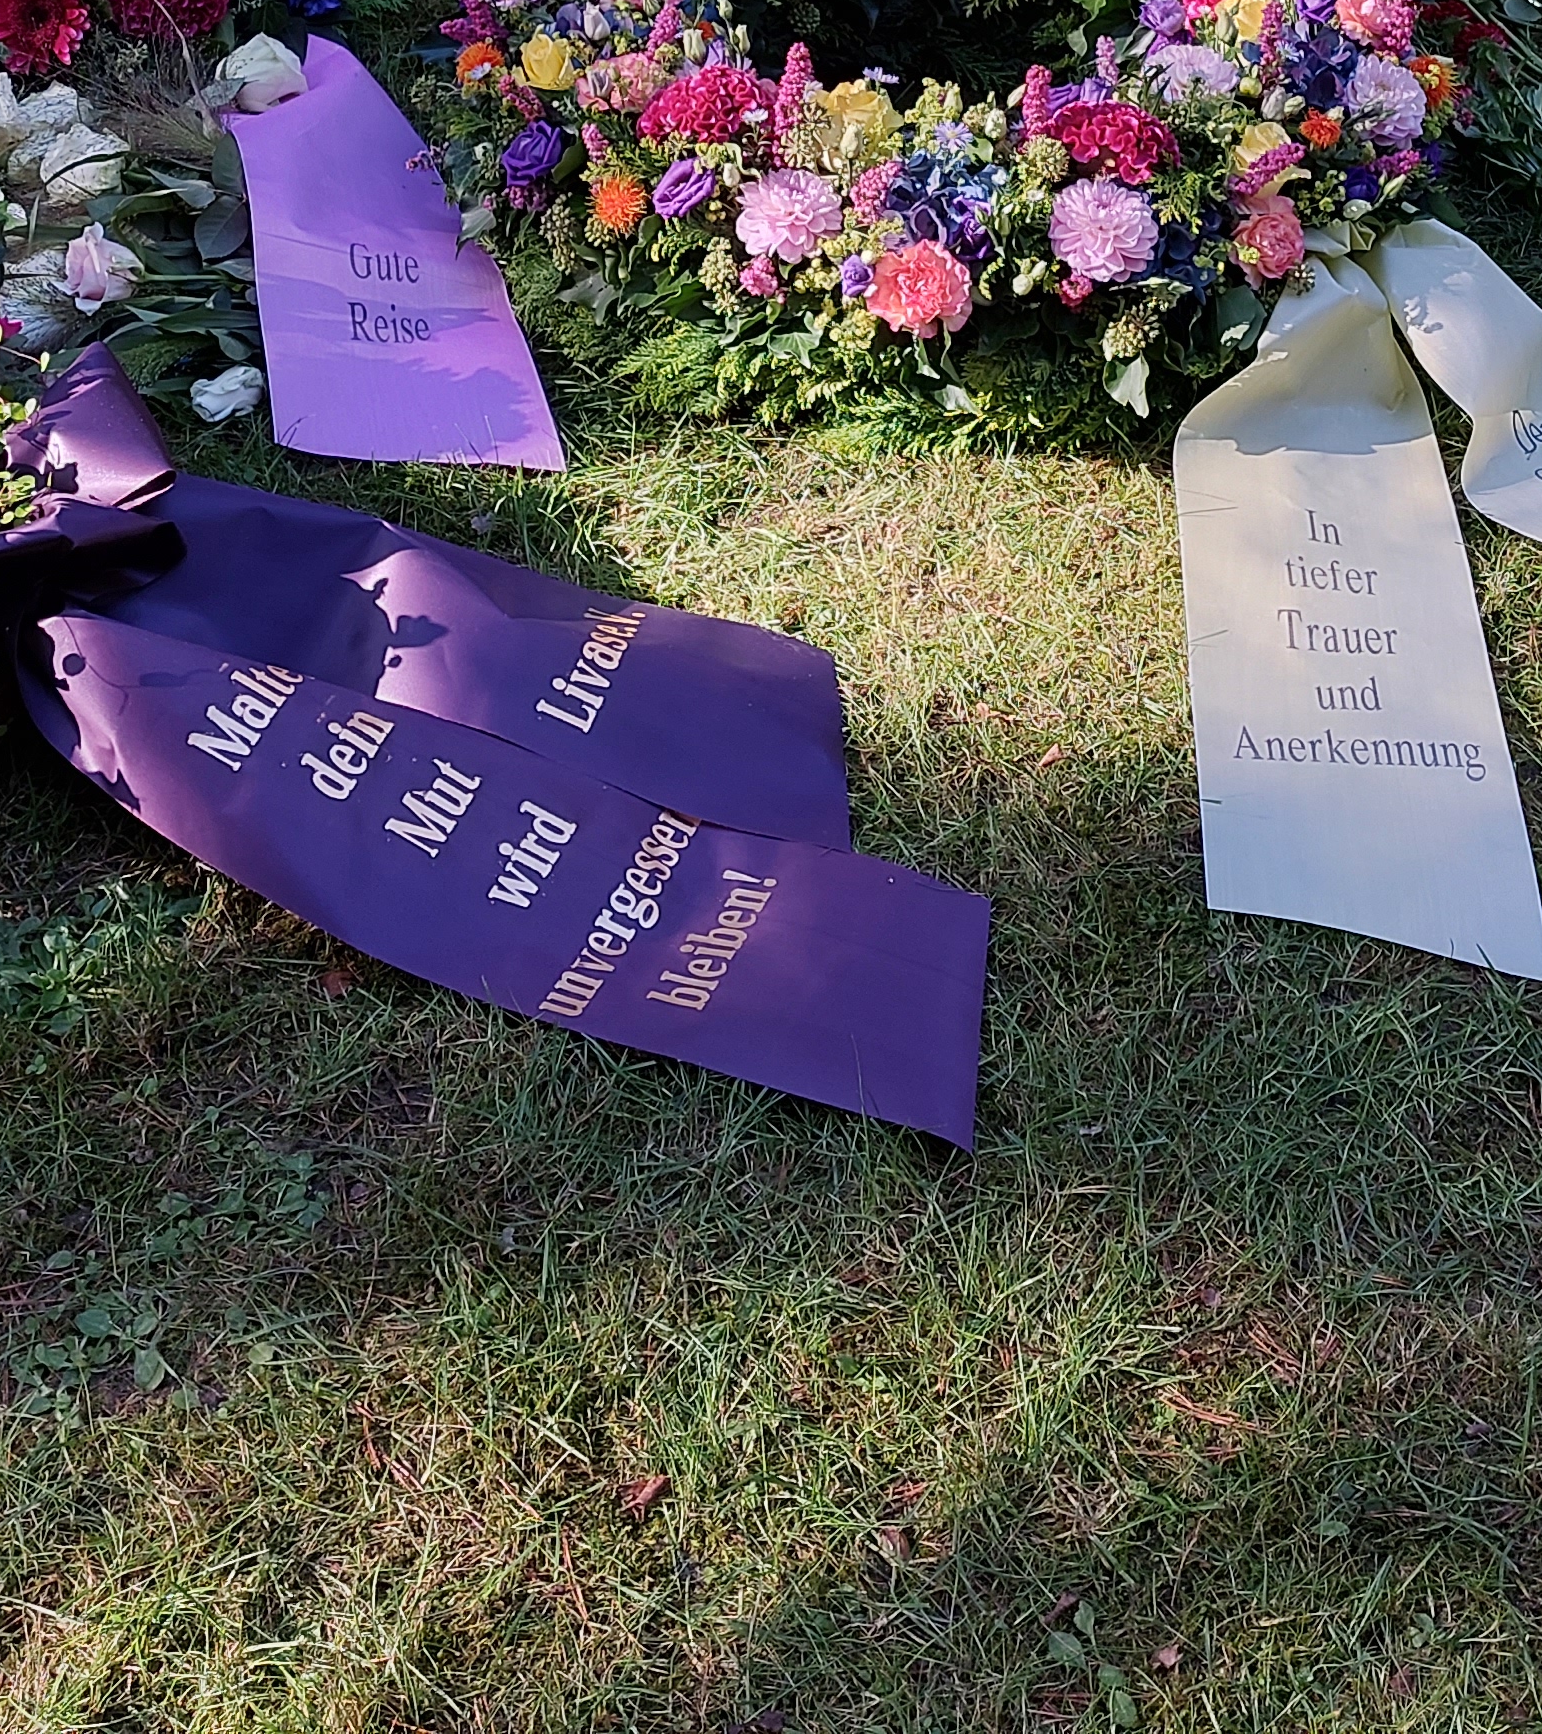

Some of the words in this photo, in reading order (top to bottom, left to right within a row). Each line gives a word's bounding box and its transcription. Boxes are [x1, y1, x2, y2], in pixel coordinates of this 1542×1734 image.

[349, 242, 420, 284] Gute
[347, 301, 431, 344] Reise
[1305, 508, 1342, 546] In
[1285, 555, 1378, 595] tiefer
[1277, 608, 1398, 655] Trauer
[187, 662, 306, 772] Malte
[1315, 676, 1382, 711] und
[300, 709, 396, 801] dein
[1233, 724, 1487, 782] Anerkennung
[383, 757, 483, 858] Mut
[487, 799, 578, 908] wird
[645, 867, 778, 1011] bleiben!
